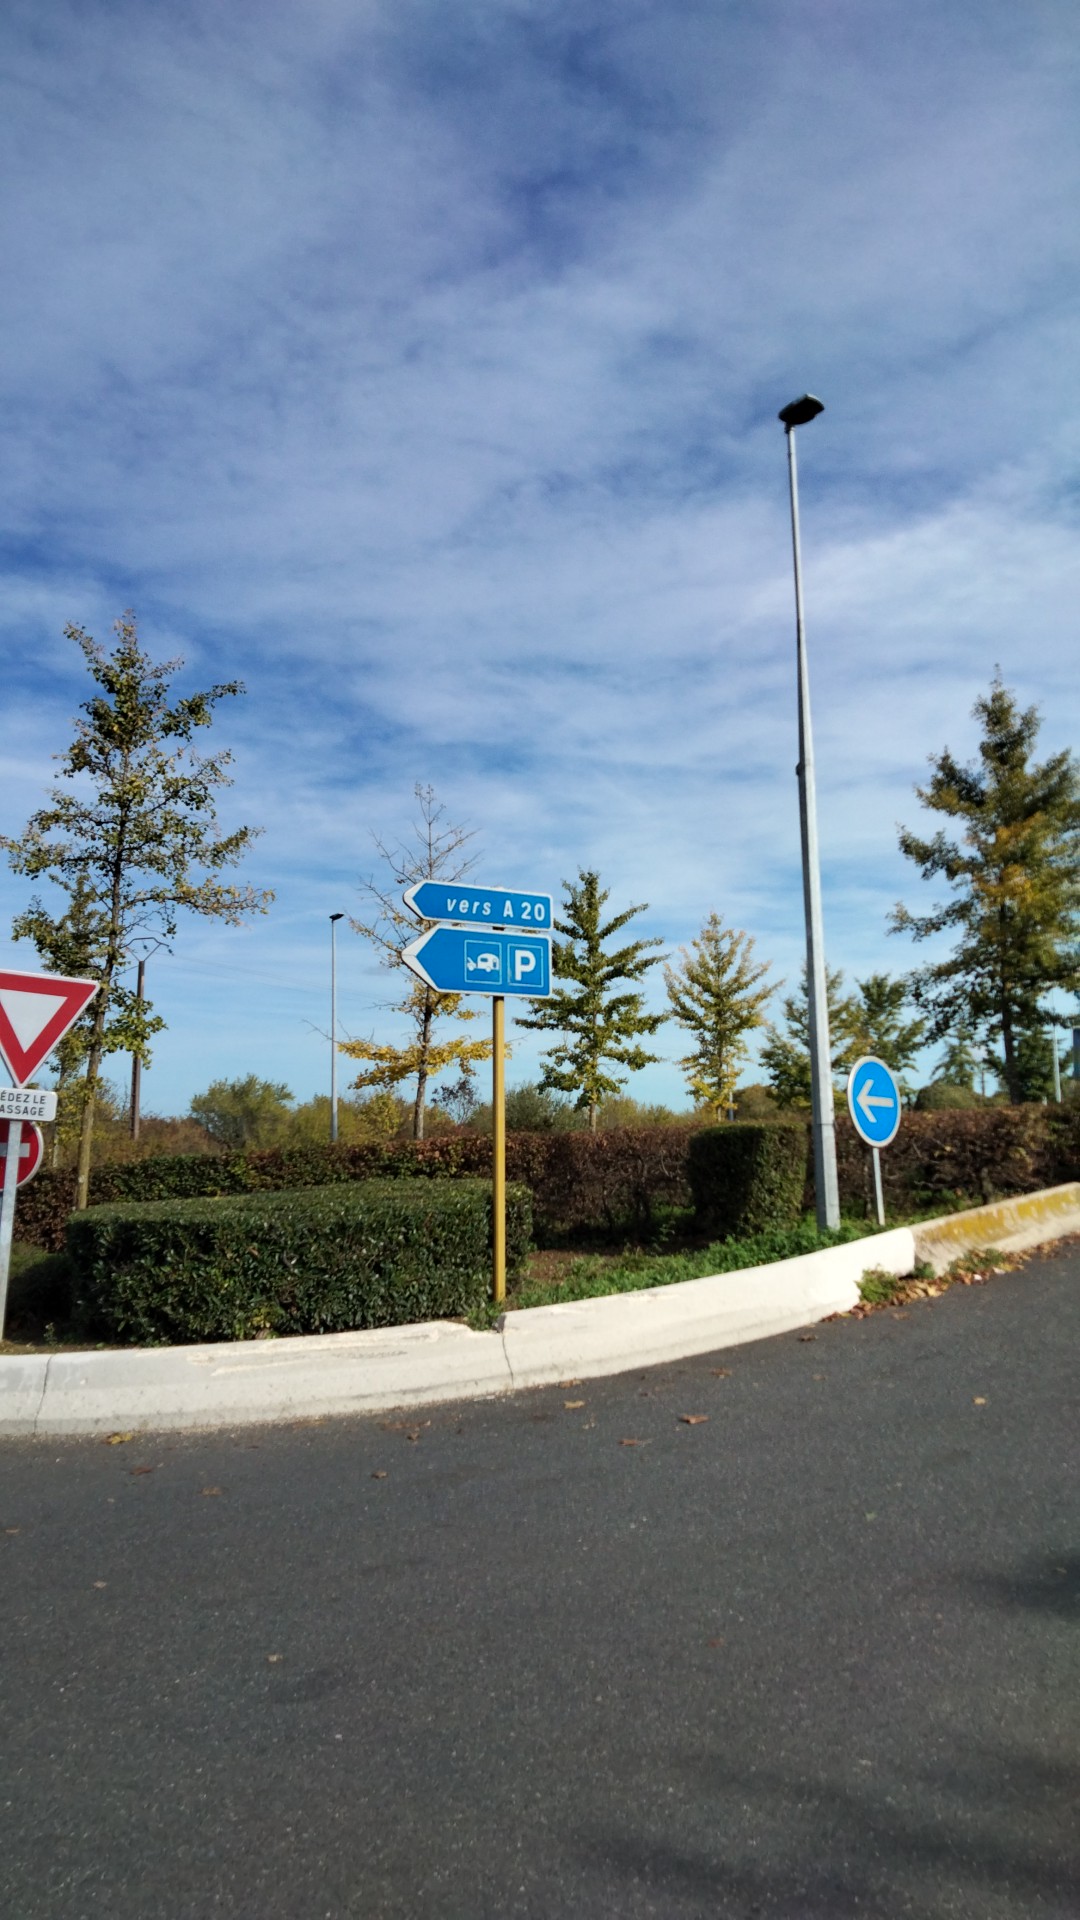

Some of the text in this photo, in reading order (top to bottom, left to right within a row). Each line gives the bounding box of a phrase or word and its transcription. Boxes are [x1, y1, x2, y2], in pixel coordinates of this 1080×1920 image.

[446, 898, 546, 921] vers A 20
[514, 949, 536, 981] P
[0, 1090, 46, 1105] ÉDEZ LE
[0, 1104, 45, 1117] ASSAGE
